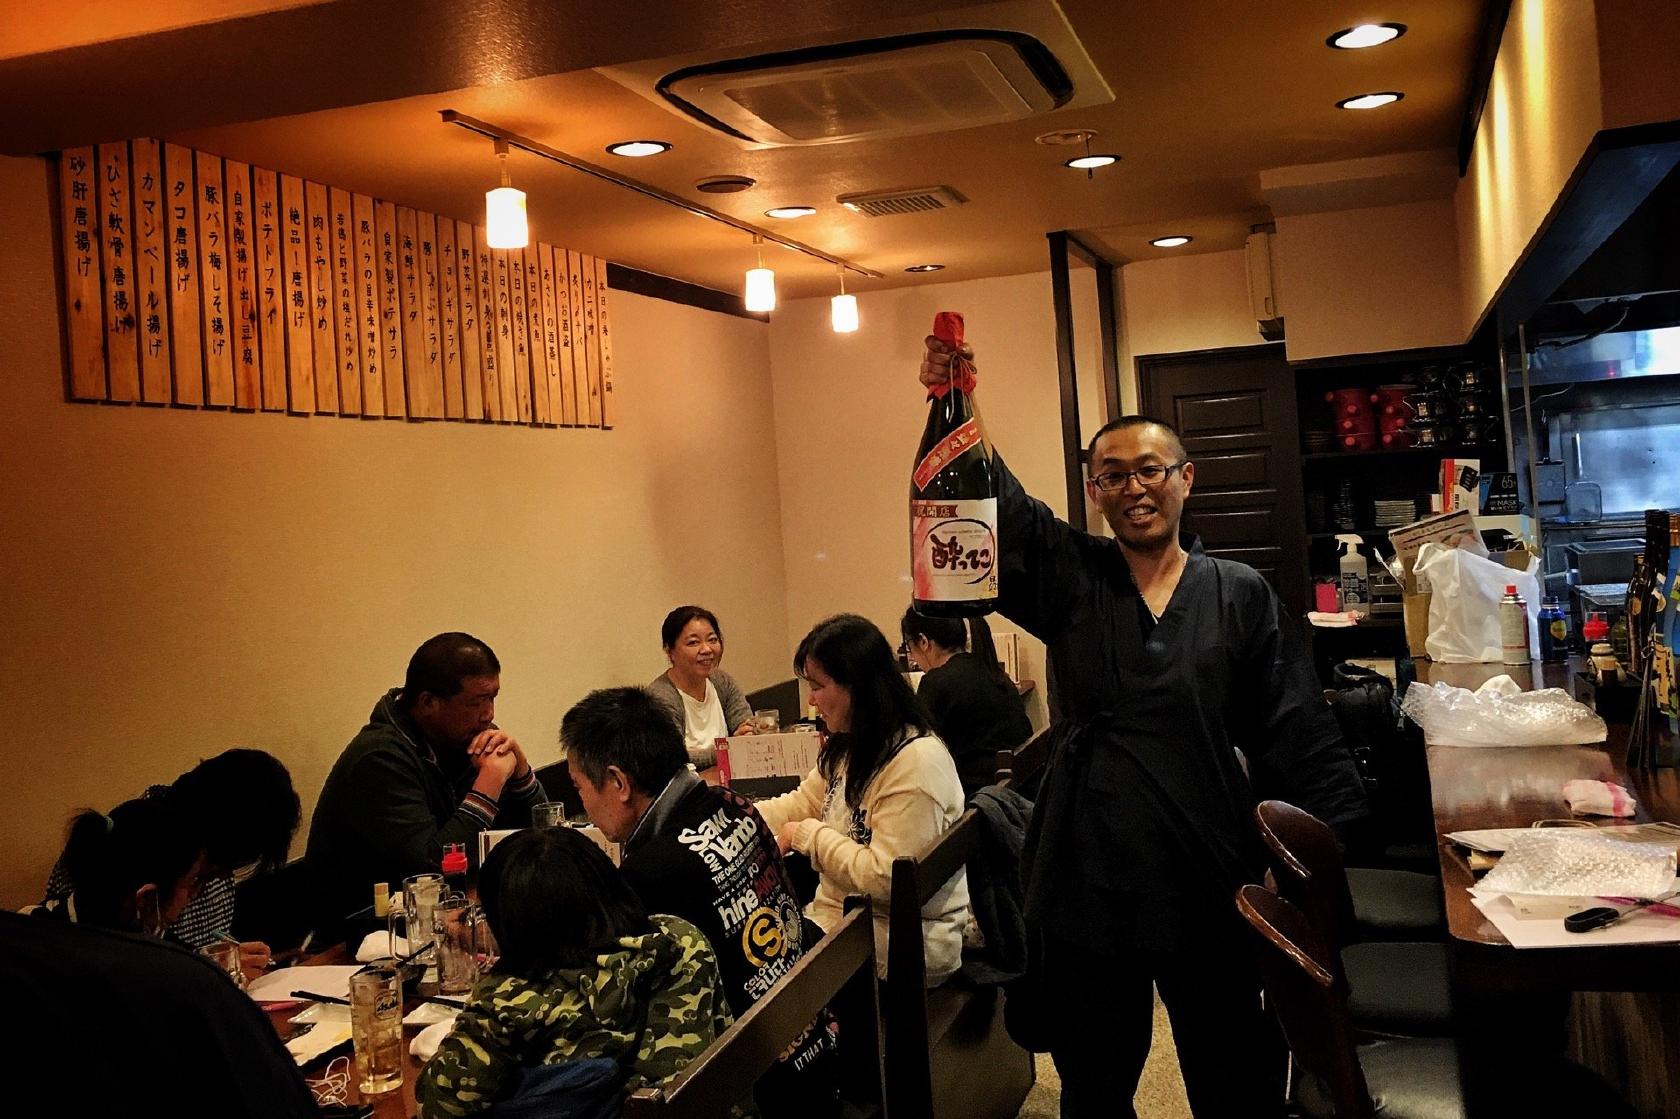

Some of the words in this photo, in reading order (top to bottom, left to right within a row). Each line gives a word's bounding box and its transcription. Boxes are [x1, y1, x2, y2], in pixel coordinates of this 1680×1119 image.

[70, 157, 91, 276] 砂肝唐揚げ
[142, 173, 162, 358] カマンベール揚げ
[174, 181, 190, 291] タコ唐揚げ
[205, 186, 225, 356] 豚バラ梅しそ揚げ
[261, 202, 276, 324] ポテトフライ
[313, 216, 328, 330] 肉もやし炒め
[234, 192, 253, 365] 自家製揚げ出し豆腐
[384, 232, 397, 359] 自家製ポテサラ
[403, 235, 417, 321] 海鮮サラダ
[462, 248, 474, 330] 野菜サラダ
[498, 259, 509, 340] 本日の刺身
